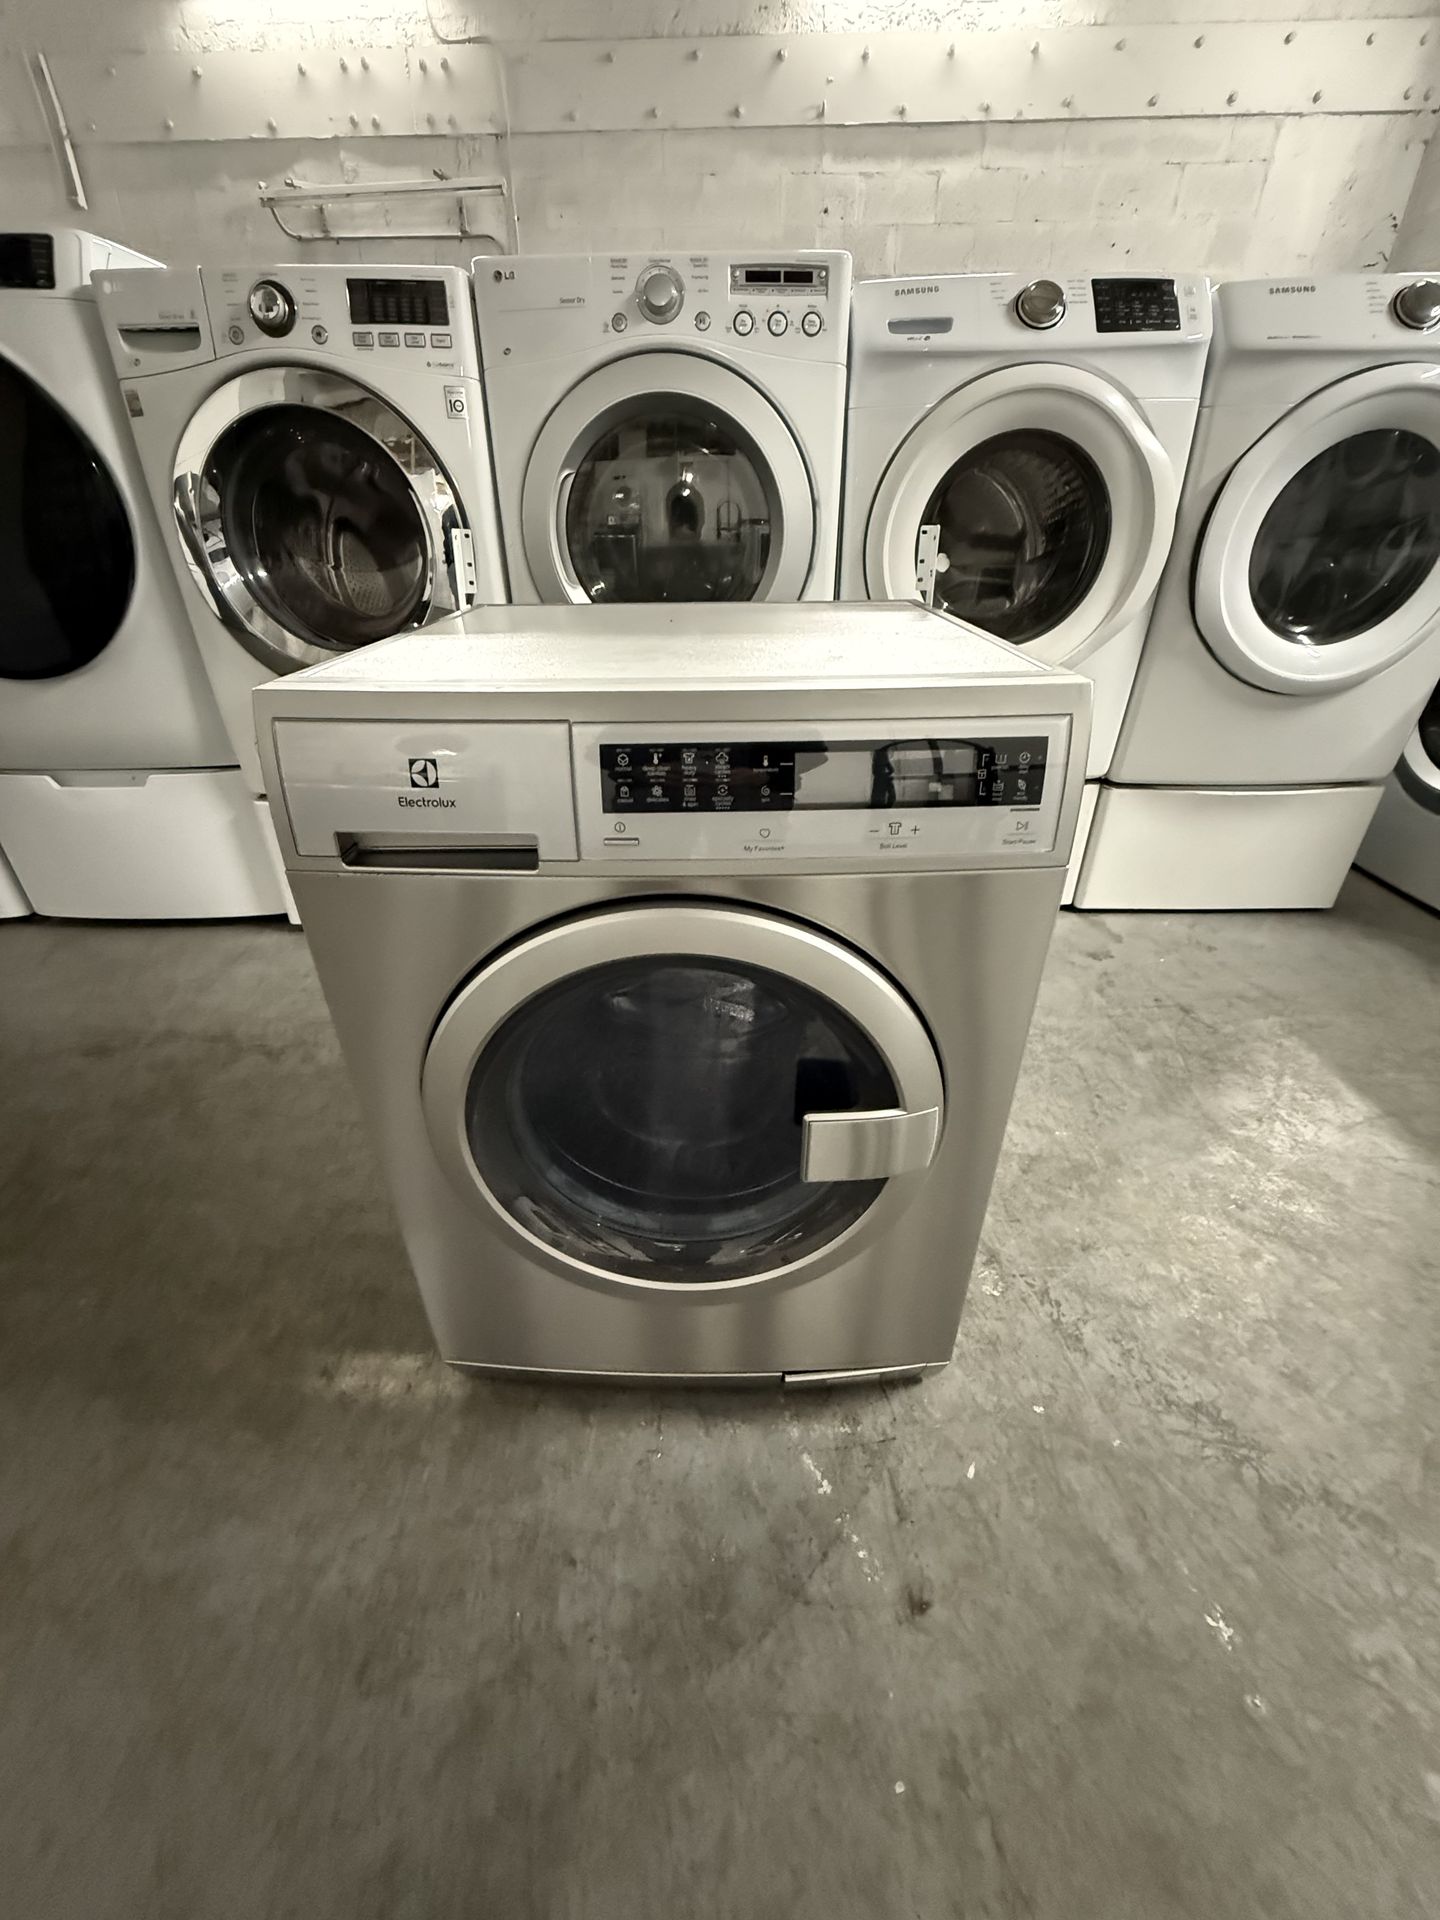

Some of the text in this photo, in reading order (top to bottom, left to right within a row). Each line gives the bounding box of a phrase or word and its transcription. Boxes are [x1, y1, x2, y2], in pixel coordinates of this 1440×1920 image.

[504, 271, 515, 280] LG
[894, 285, 940, 297] SAMSUNG
[1269, 285, 1316, 295] SAMSUNG
[449, 399, 464, 413] 10
[398, 796, 456, 808] Electrolux
